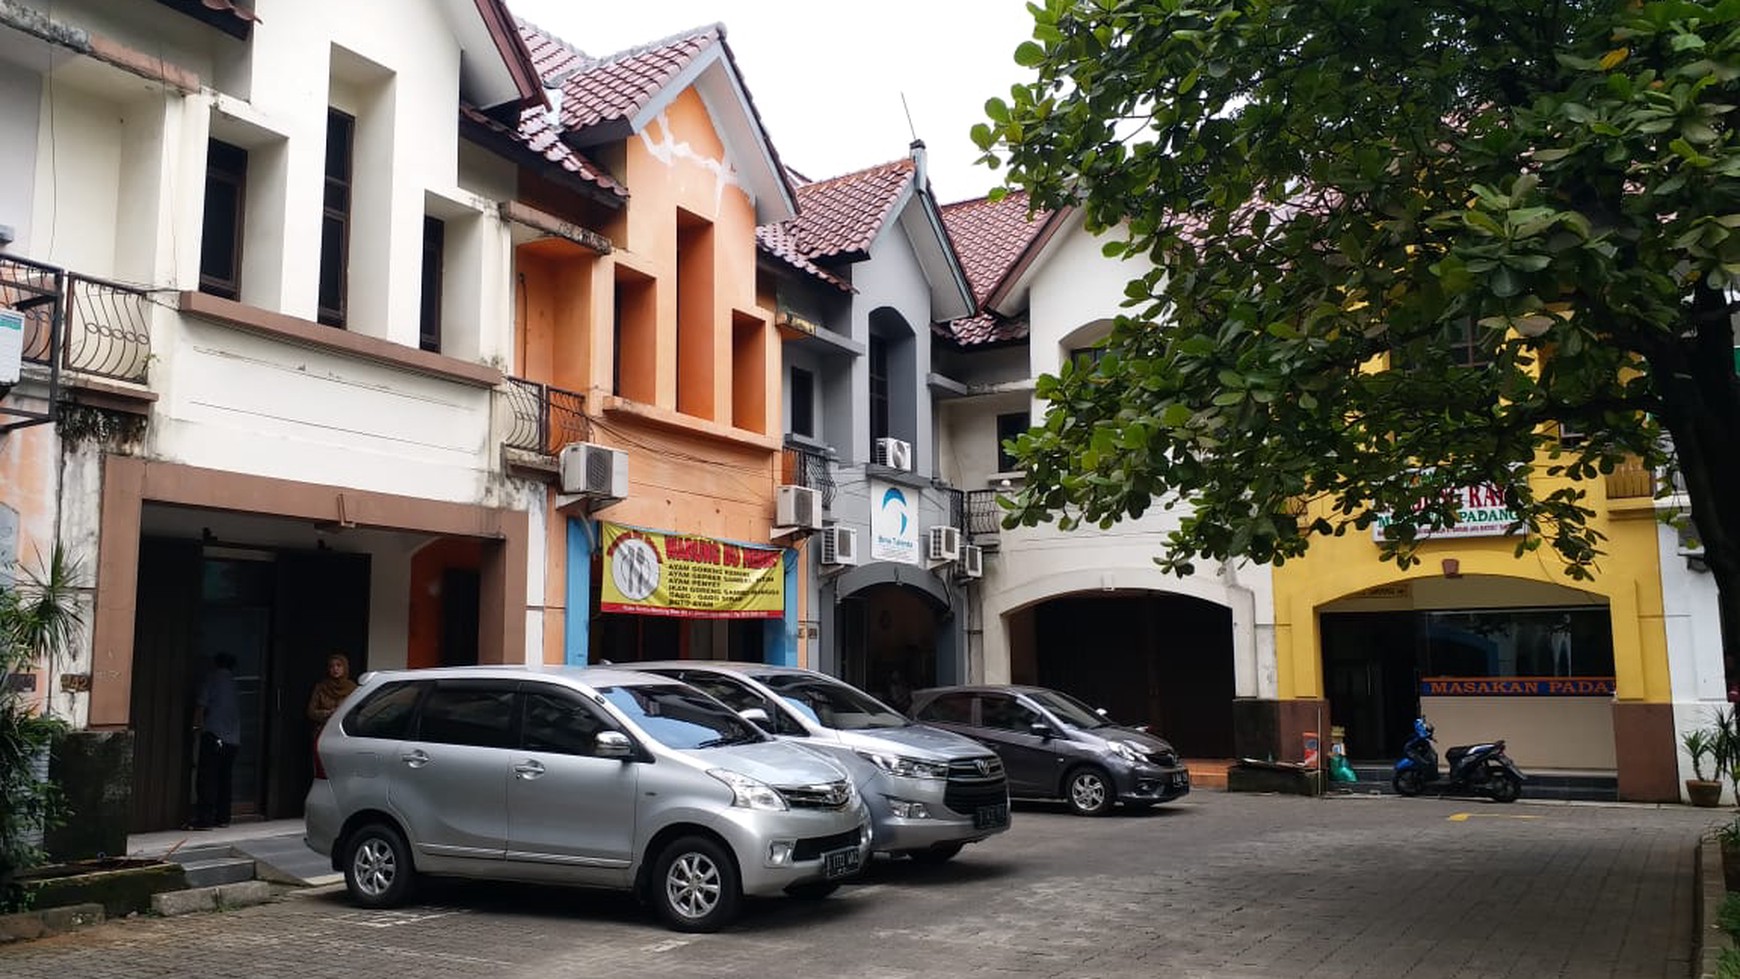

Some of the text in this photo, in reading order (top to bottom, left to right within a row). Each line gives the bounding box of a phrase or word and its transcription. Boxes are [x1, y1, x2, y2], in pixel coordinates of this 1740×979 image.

[664, 535, 720, 565] WARUNG
[692, 566, 722, 574] GORENG
[692, 580, 720, 588] PENYET
[690, 586, 722, 595] GORENG
[692, 600, 714, 608] AYAM
[1430, 682, 1539, 694] MASAKAN
